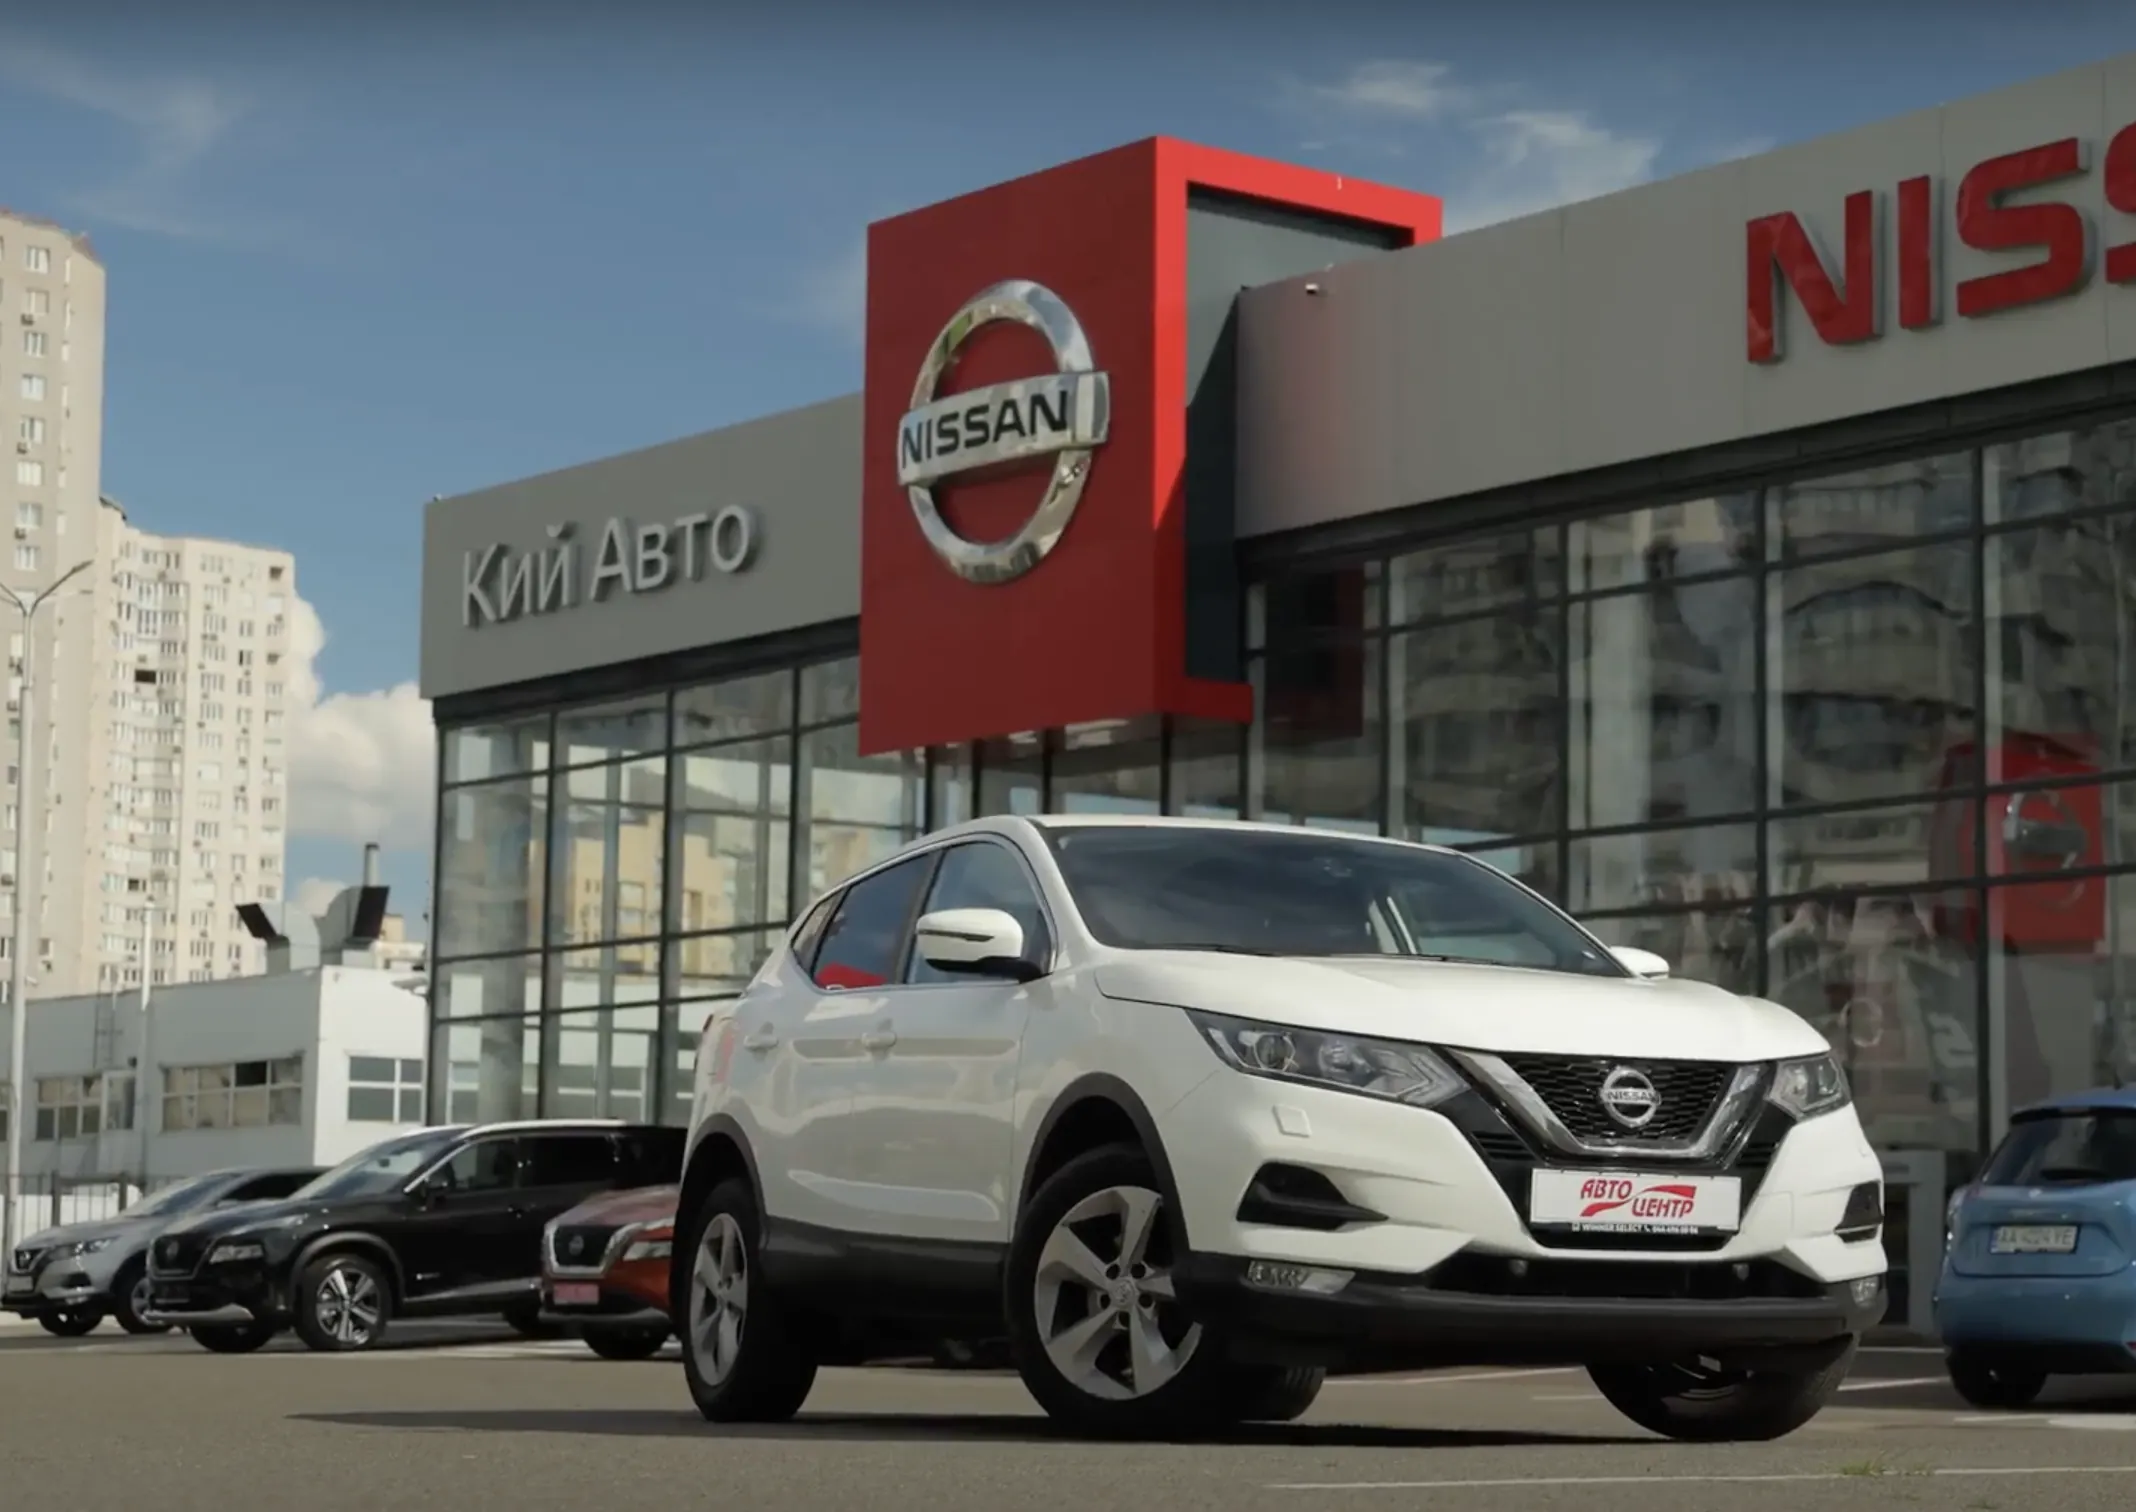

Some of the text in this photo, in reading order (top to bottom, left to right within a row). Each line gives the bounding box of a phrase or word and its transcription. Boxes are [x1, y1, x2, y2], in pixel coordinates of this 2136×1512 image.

[1746, 121, 2136, 363] NIS
[902, 390, 1068, 469] NISSAN
[462, 523, 574, 627] Кий
[1607, 1090, 1655, 1102] NISSAN
[1580, 1179, 1633, 1200] АВТО
[1632, 1199, 1695, 1219] ЦЕНТР
